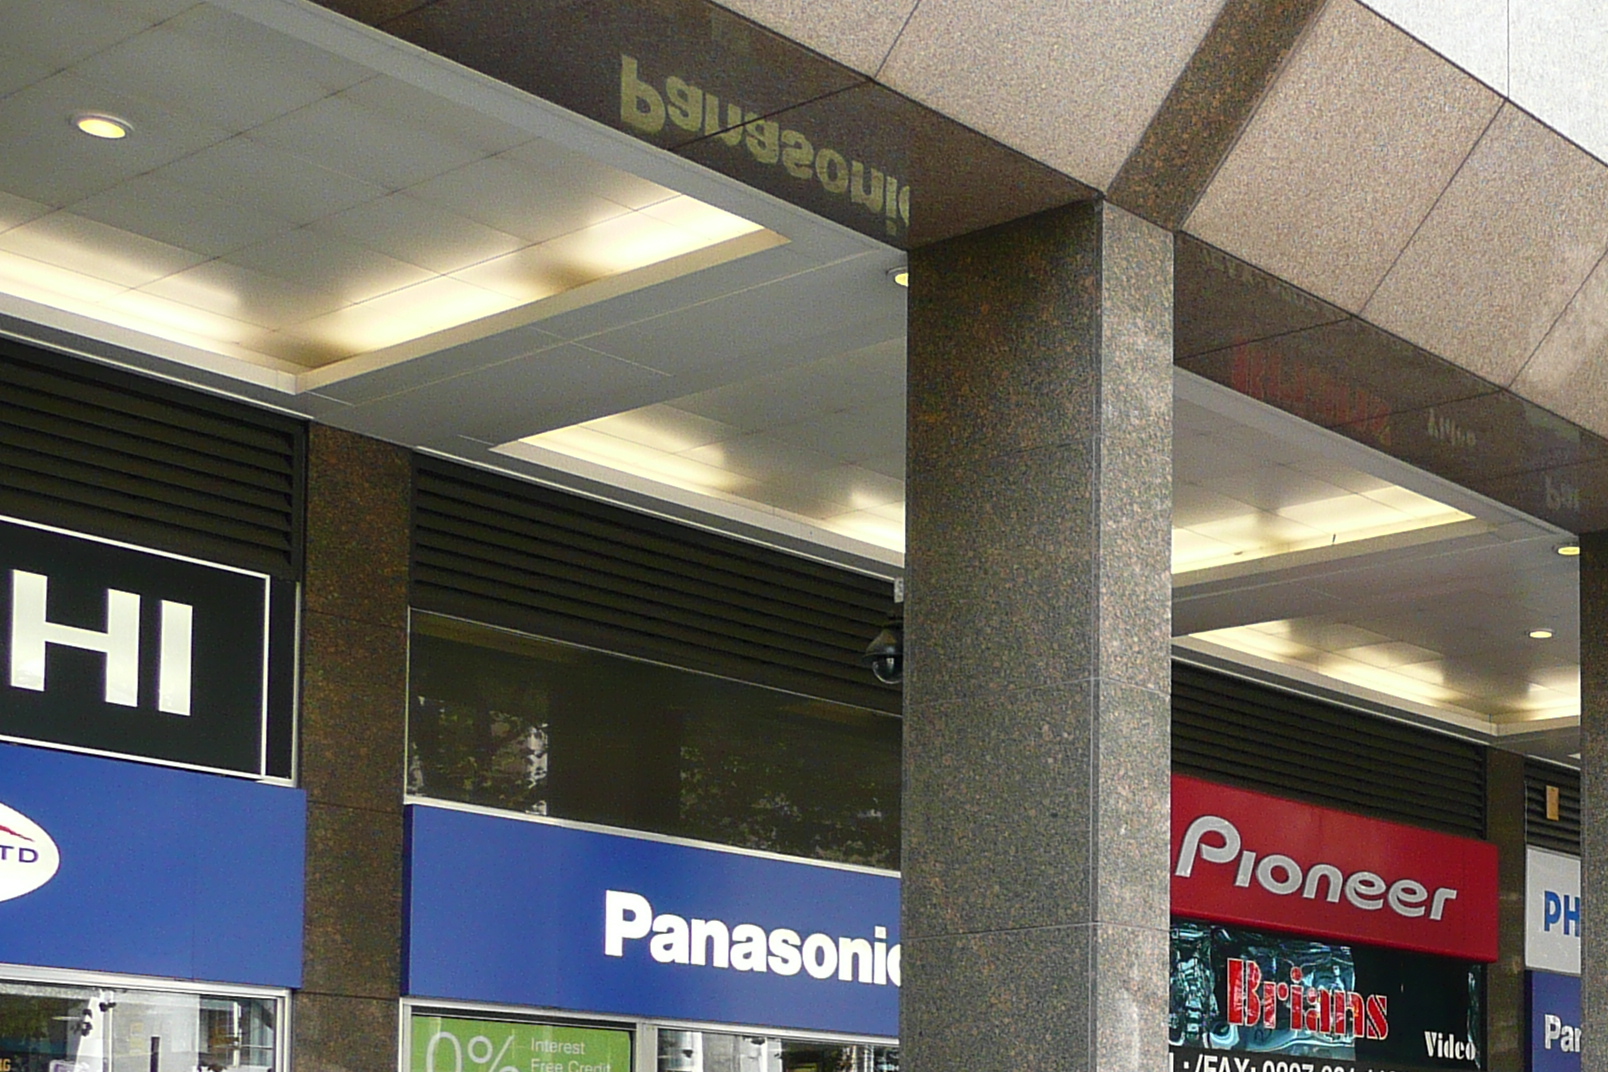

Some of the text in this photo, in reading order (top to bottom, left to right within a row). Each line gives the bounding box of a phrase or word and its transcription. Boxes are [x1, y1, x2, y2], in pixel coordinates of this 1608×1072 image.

[9, 567, 194, 717] HI
[1174, 814, 1458, 921] Pioneer
[1226, 957, 1389, 1041] Brians
[529, 1037, 587, 1056] Interest
[1424, 1030, 1476, 1062] Video
